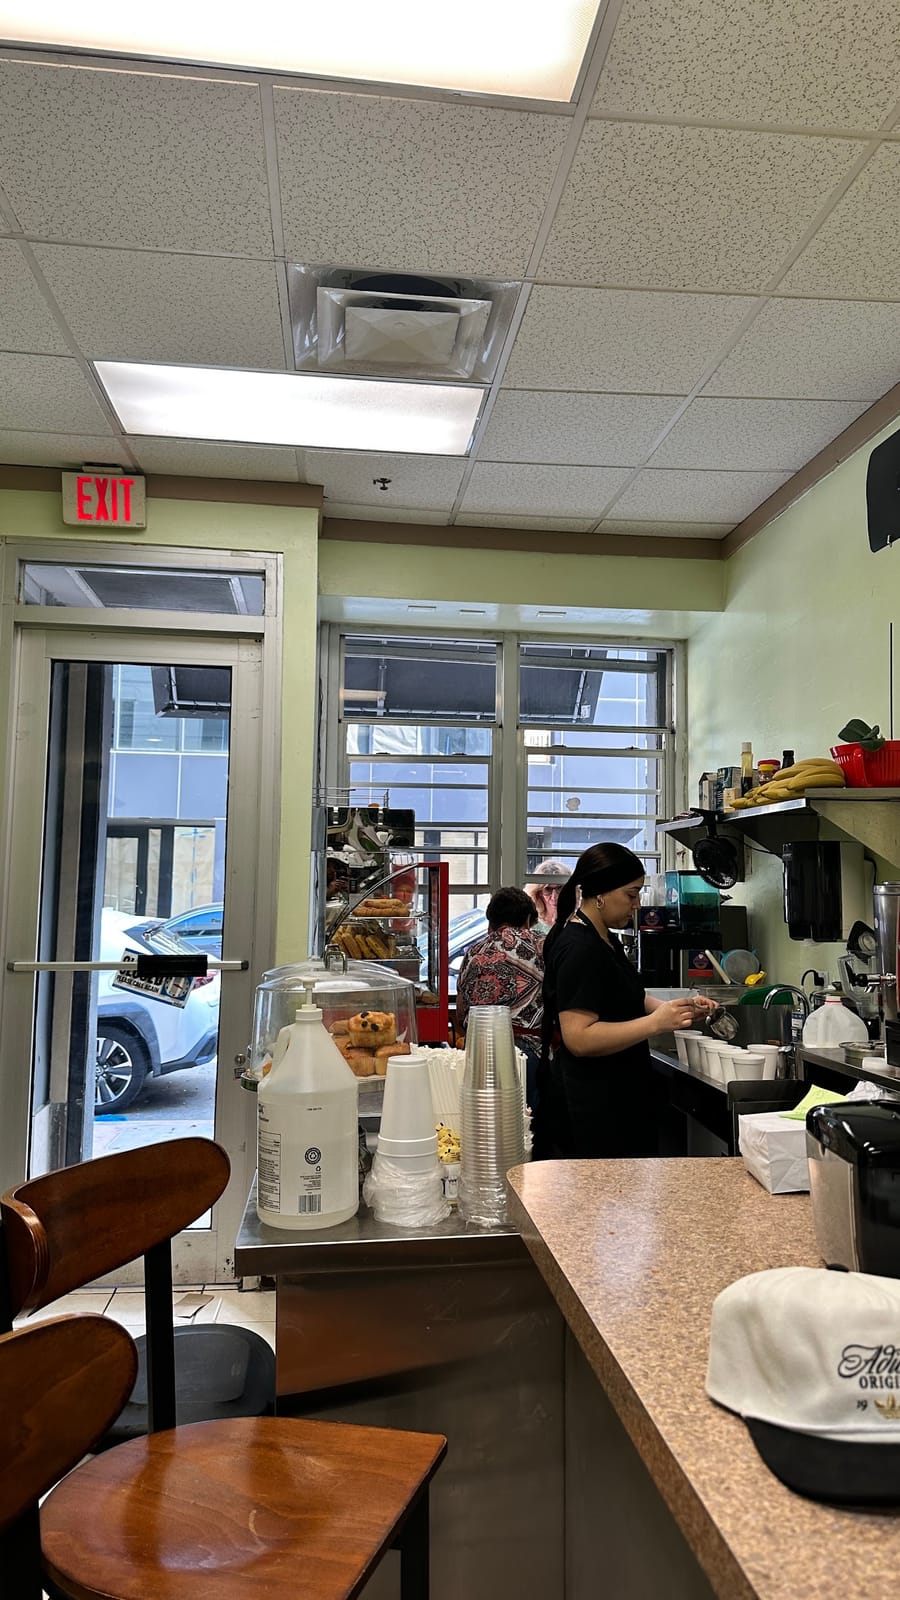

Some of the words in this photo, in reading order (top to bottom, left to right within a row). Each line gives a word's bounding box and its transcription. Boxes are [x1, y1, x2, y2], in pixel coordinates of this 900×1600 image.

[77, 476, 134, 522] EXIT
[837, 1344, 900, 1378] Adi
[856, 1399, 868, 1411] 19
